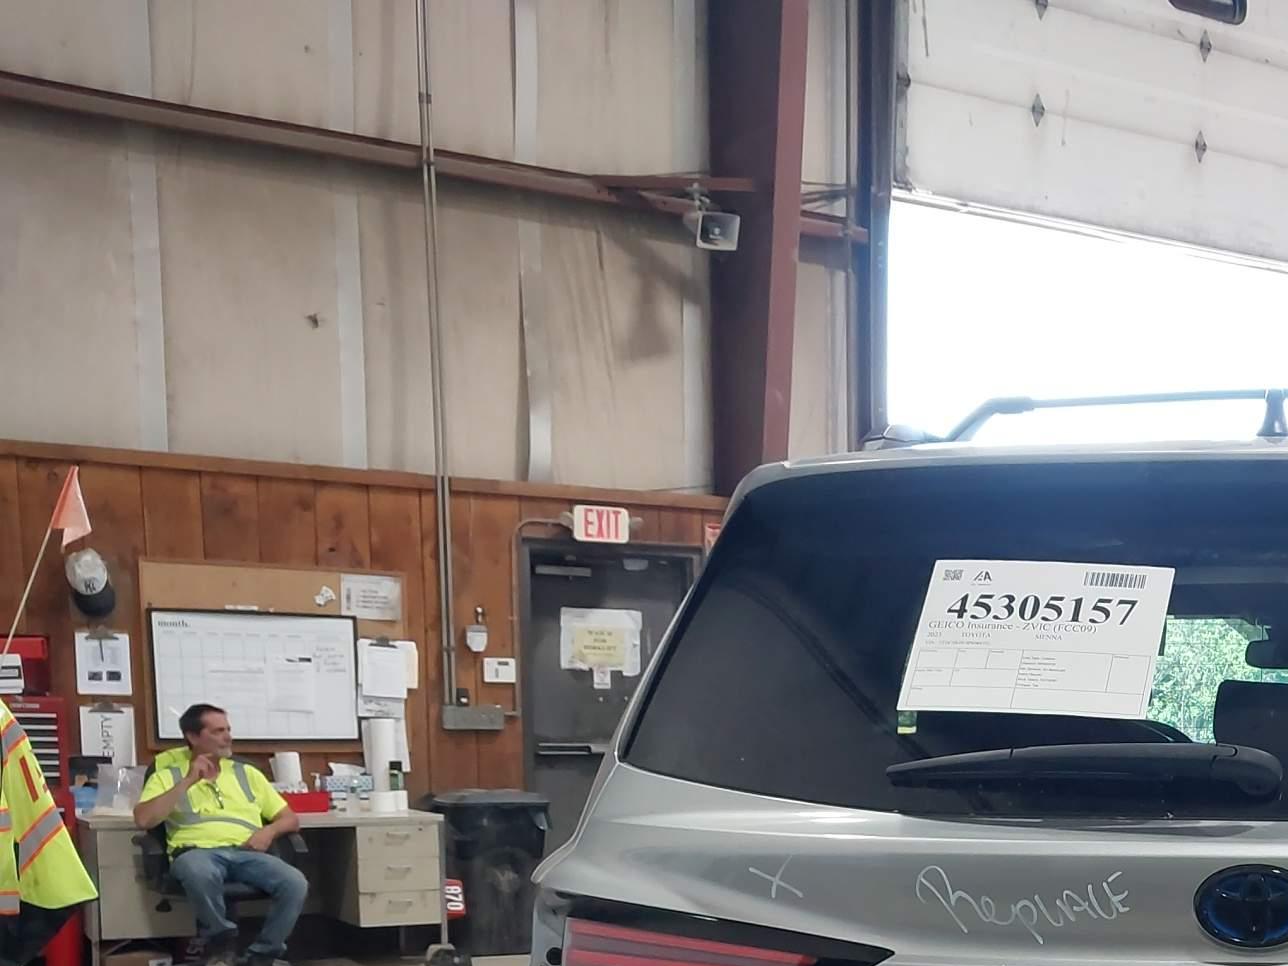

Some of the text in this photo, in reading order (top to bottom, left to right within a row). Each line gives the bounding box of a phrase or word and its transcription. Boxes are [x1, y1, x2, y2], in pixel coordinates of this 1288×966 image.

[583, 508, 622, 540] EXIT
[946, 592, 1139, 626] 45305157
[928, 620, 965, 630] GEICO
[967, 621, 1013, 631] Insurance
[1022, 622, 1051, 632] ZVIC
[1035, 633, 1063, 641] SIENNA
